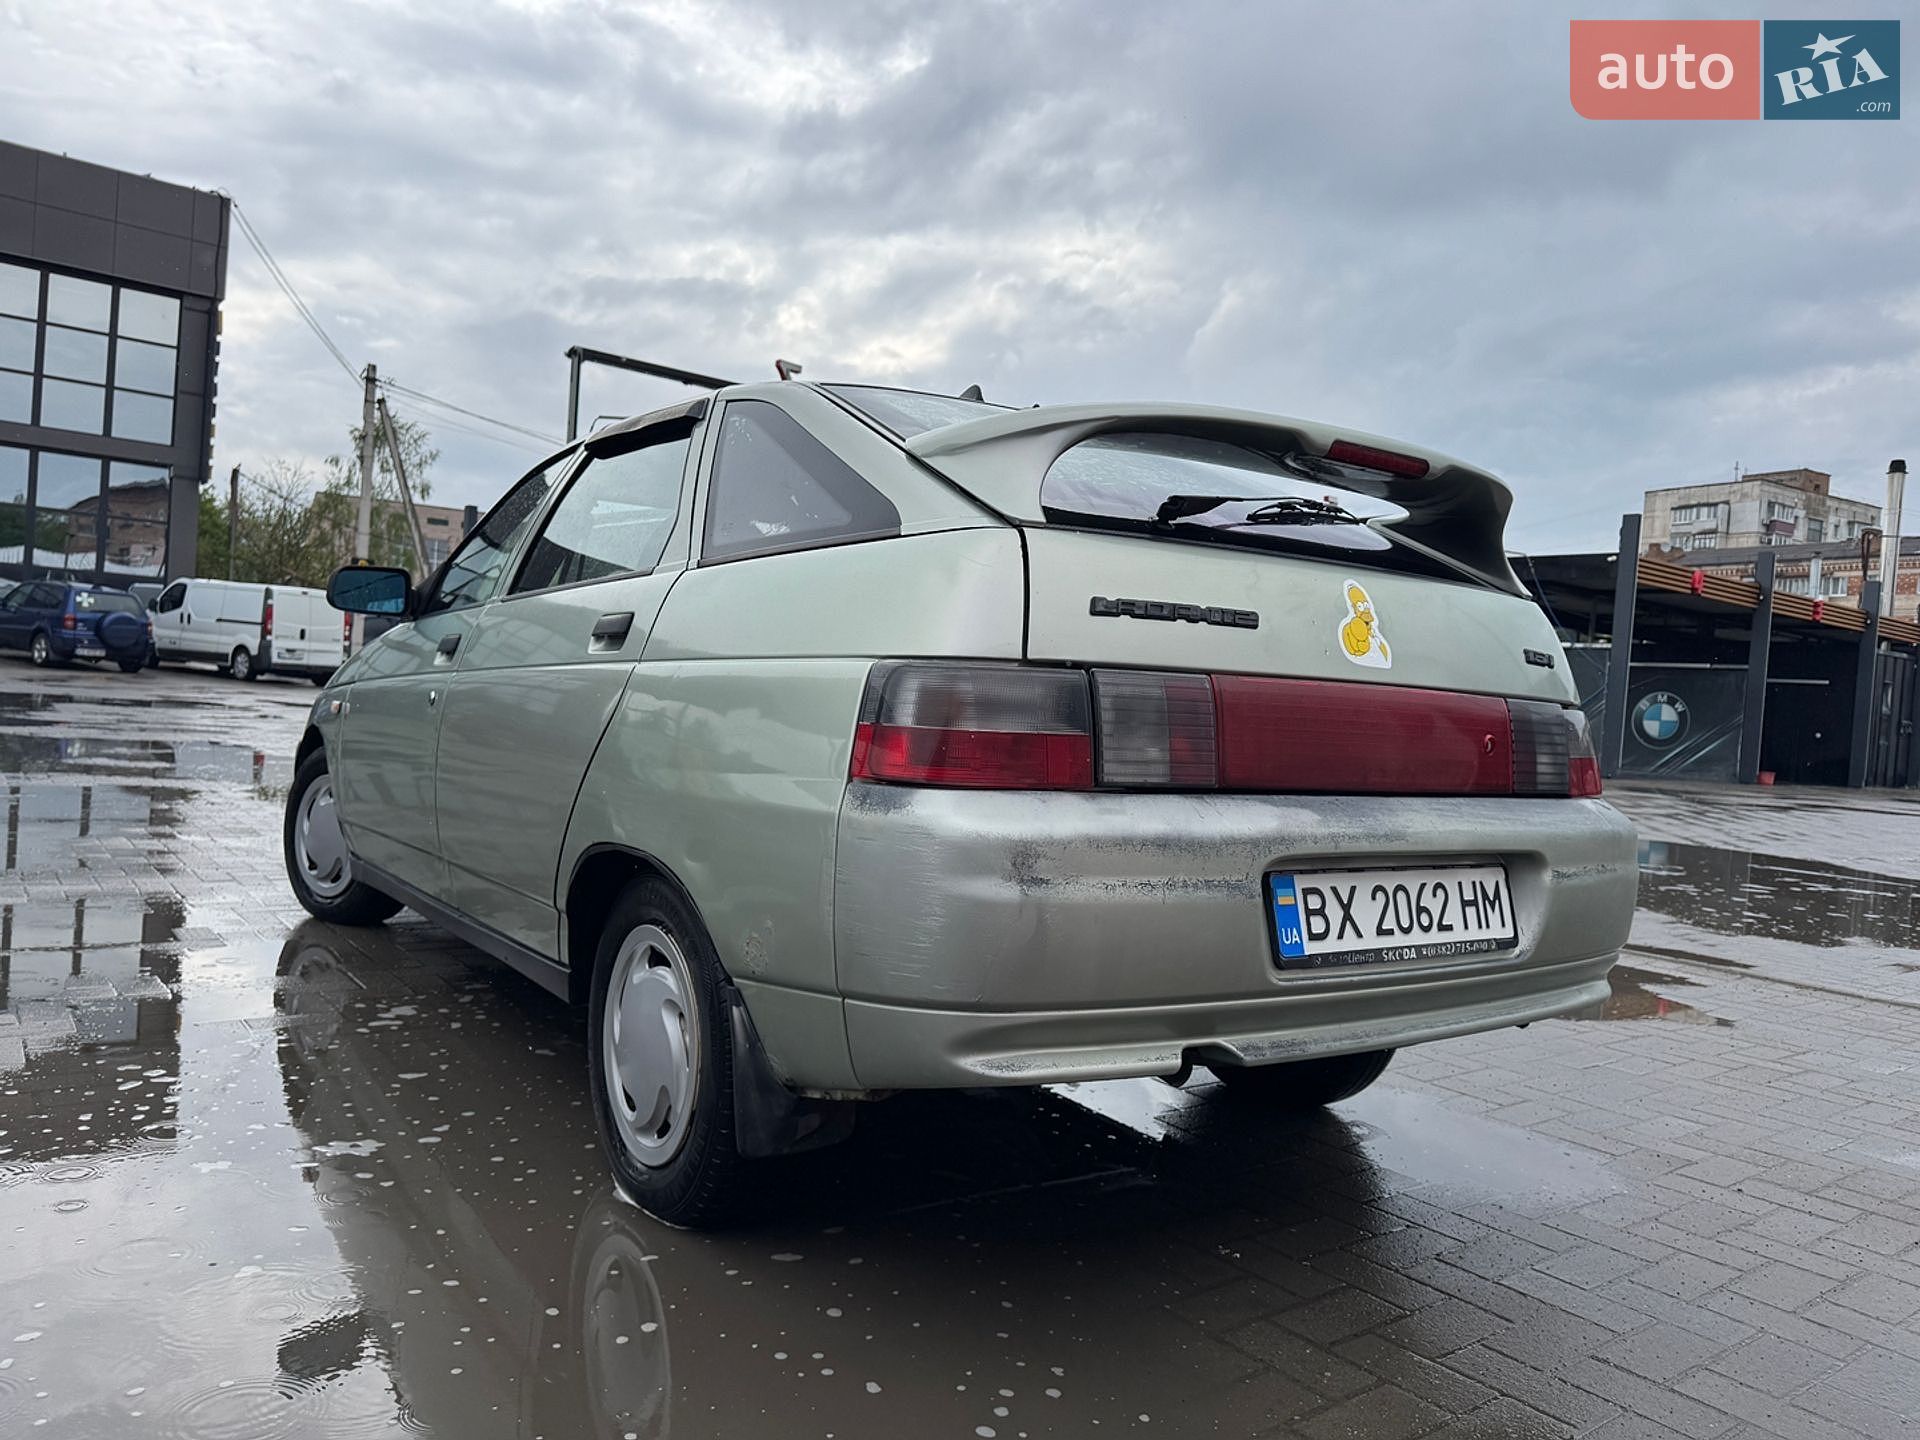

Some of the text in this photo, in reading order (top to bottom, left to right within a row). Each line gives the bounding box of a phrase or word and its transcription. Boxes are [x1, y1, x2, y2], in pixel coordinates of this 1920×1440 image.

[1090, 596, 1203, 624] LADA
[1639, 694, 1686, 712] BMW
[1301, 879, 1506, 941] BX 2062 HM
[1282, 927, 1300, 945] UA
